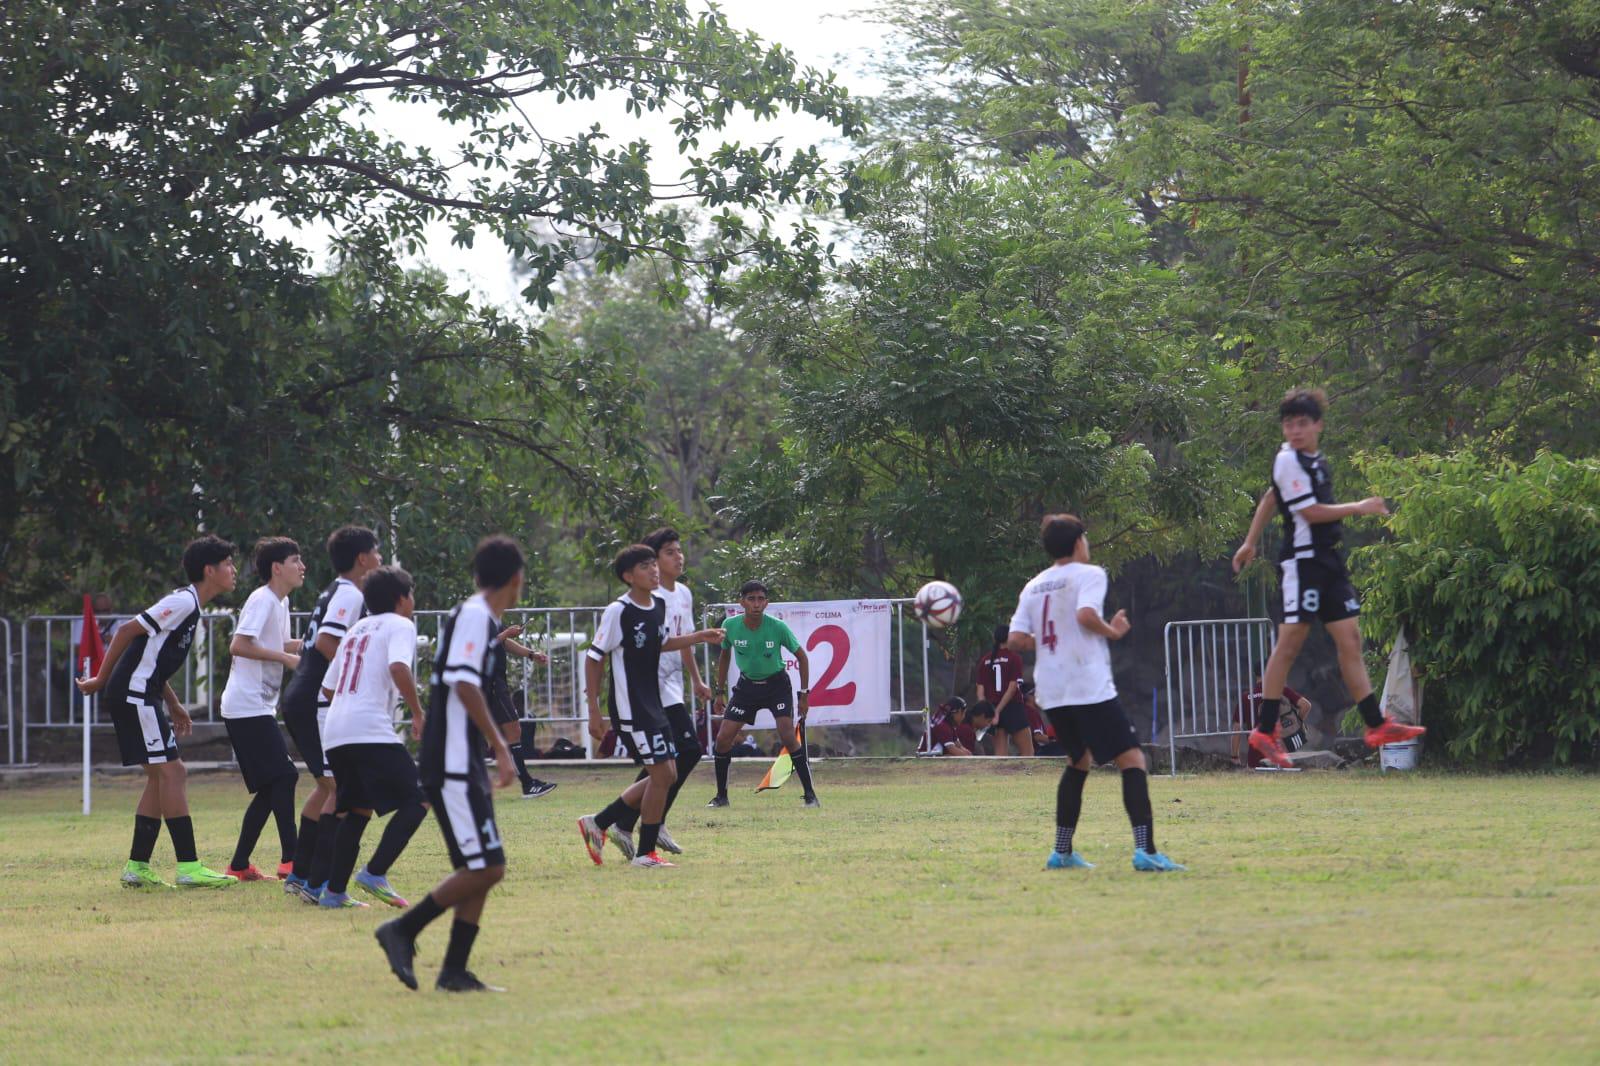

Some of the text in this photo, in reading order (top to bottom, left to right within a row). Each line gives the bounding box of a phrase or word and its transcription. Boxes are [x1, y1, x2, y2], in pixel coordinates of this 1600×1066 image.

[1301, 588, 1320, 612] 8
[815, 611, 842, 619] COLIMA
[1041, 594, 1058, 655] 4
[734, 639, 748, 647] FMF
[335, 634, 372, 696] 11
[807, 624, 858, 707] 2
[730, 706, 746, 716] FMF
[652, 733, 668, 756] 5
